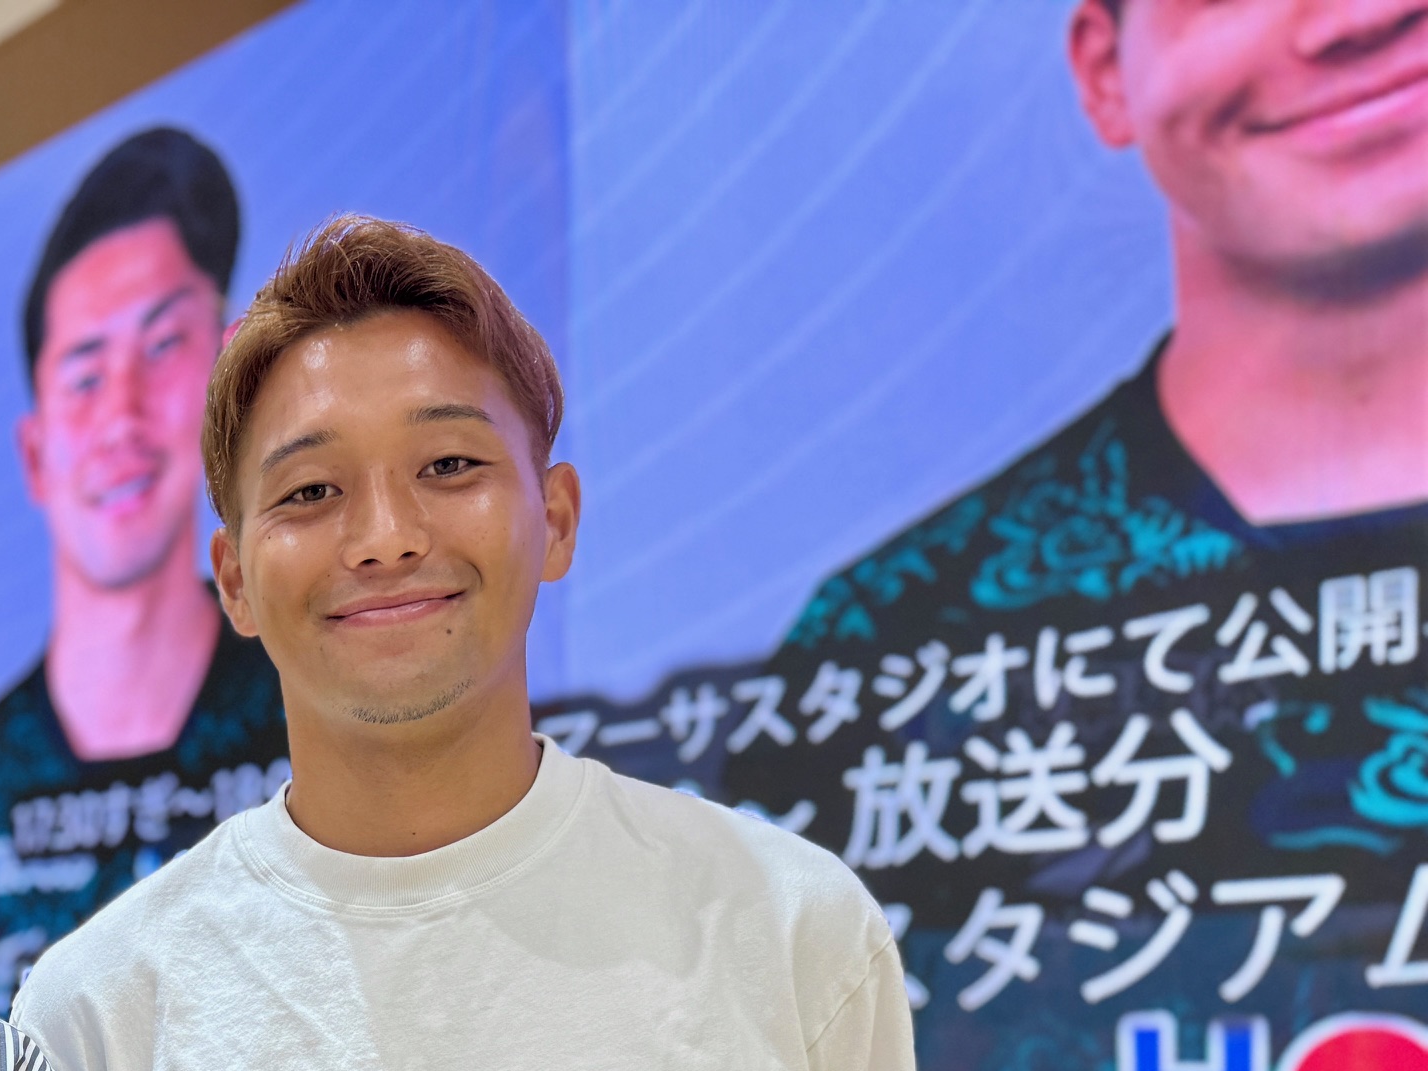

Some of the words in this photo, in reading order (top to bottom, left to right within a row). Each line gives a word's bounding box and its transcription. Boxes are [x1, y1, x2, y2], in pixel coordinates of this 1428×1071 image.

[535, 564, 1428, 766] マーサスタジオにて公開
[843, 708, 1233, 869] 放送分
